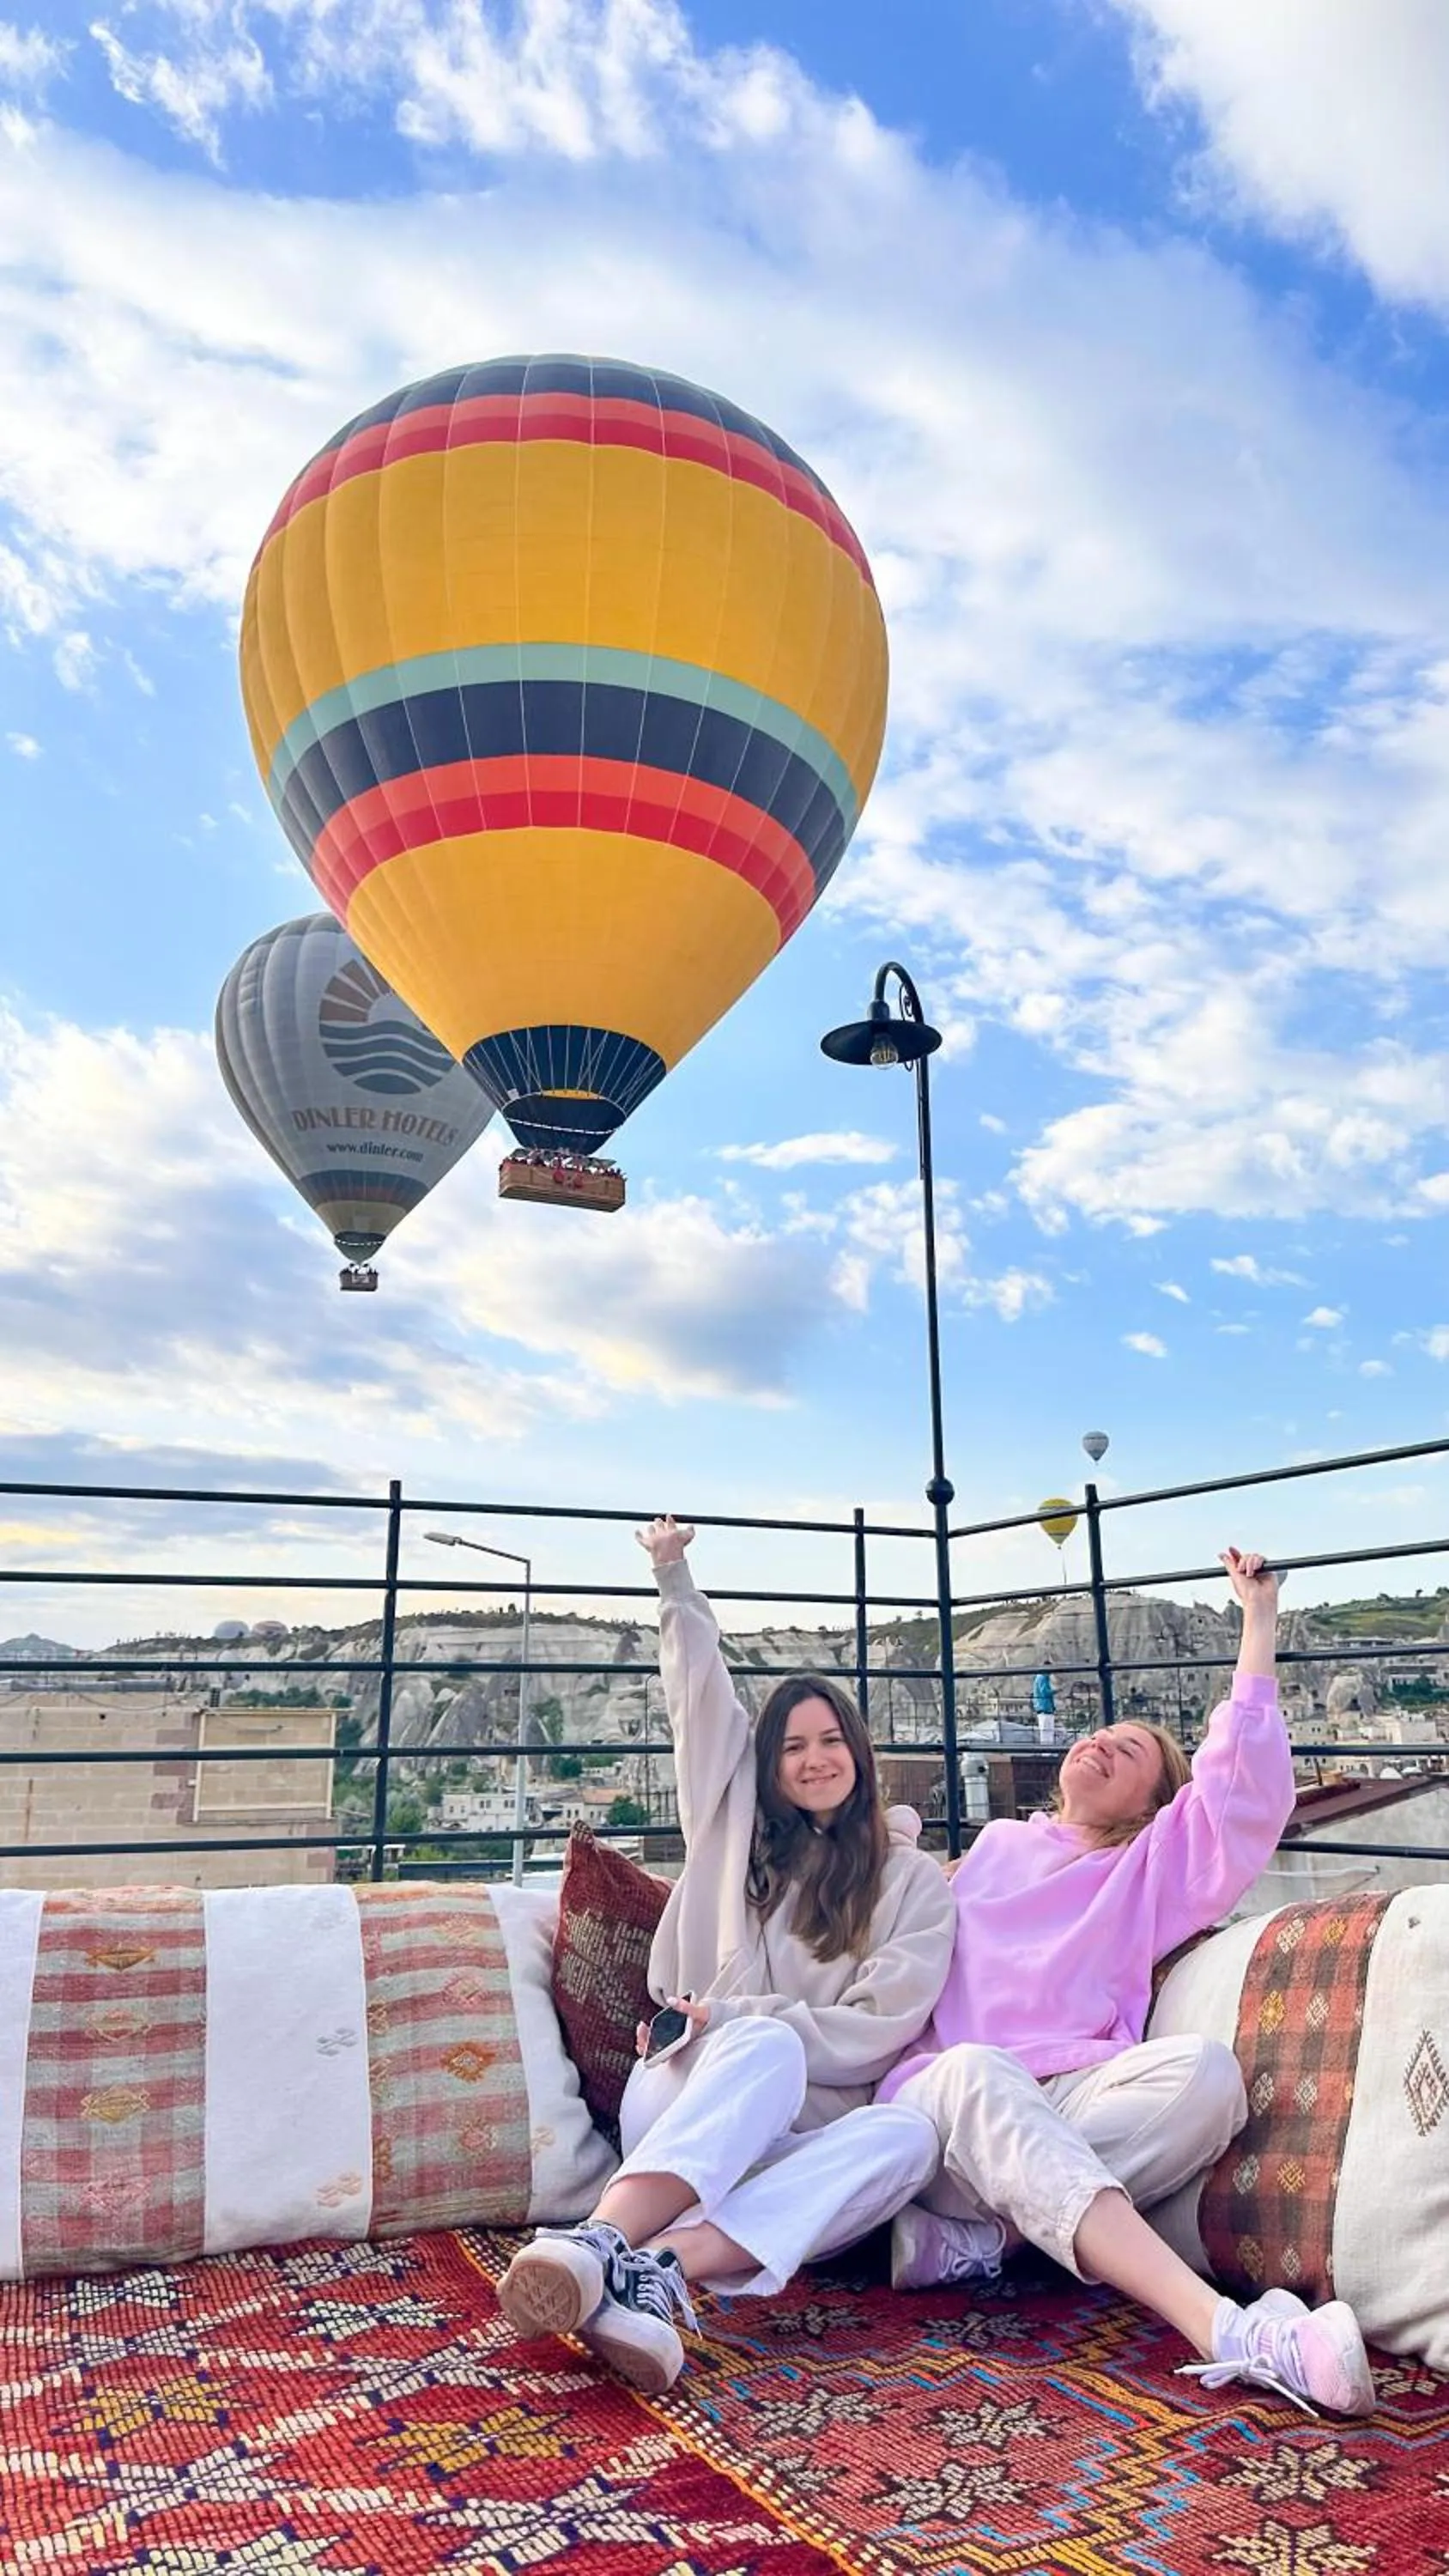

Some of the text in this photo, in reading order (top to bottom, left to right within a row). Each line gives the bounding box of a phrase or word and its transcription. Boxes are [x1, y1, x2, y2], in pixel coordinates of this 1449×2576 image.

[291, 1106, 459, 1145] DINLER HOTELS
[326, 1141, 424, 1163] www.dinler.com
